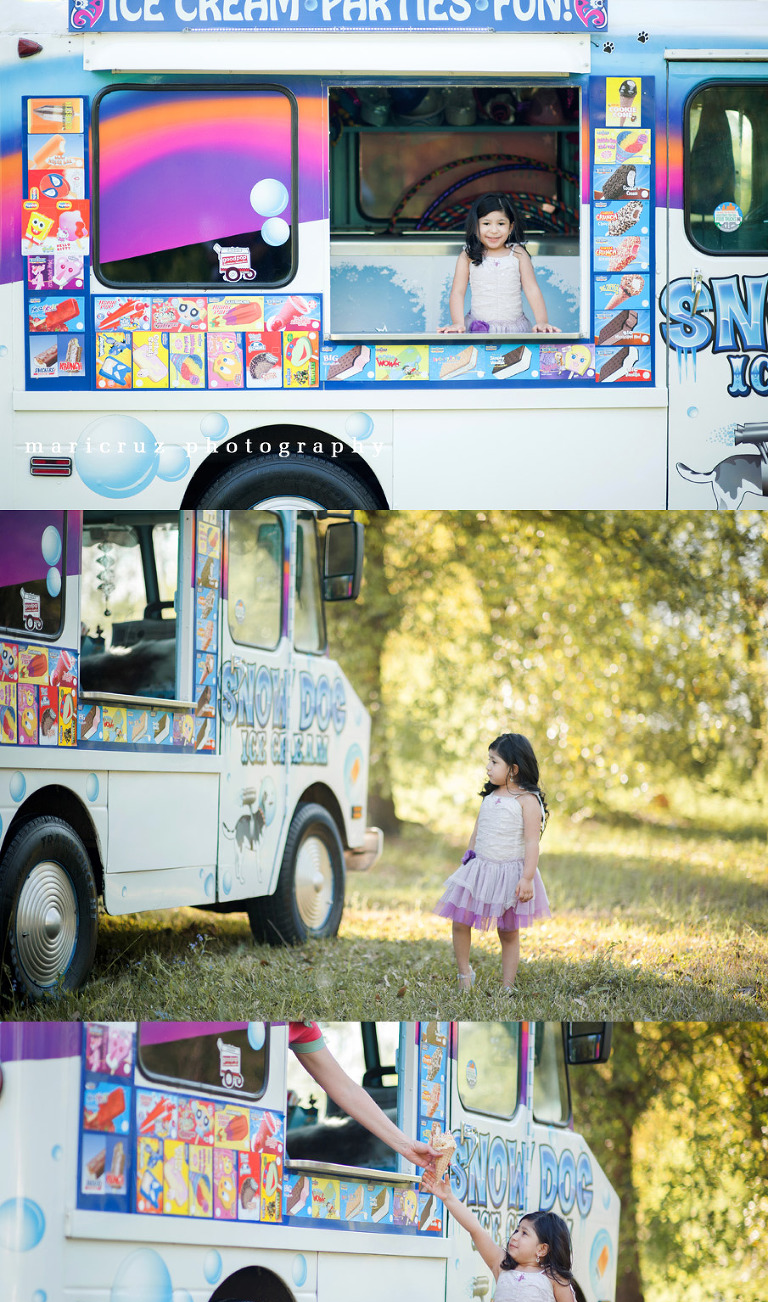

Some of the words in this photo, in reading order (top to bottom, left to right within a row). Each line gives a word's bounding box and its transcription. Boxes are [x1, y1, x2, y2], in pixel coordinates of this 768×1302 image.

[299, 670, 346, 735] DOG
[241, 730, 267, 765] ICE
[539, 1143, 594, 1218] DOG
